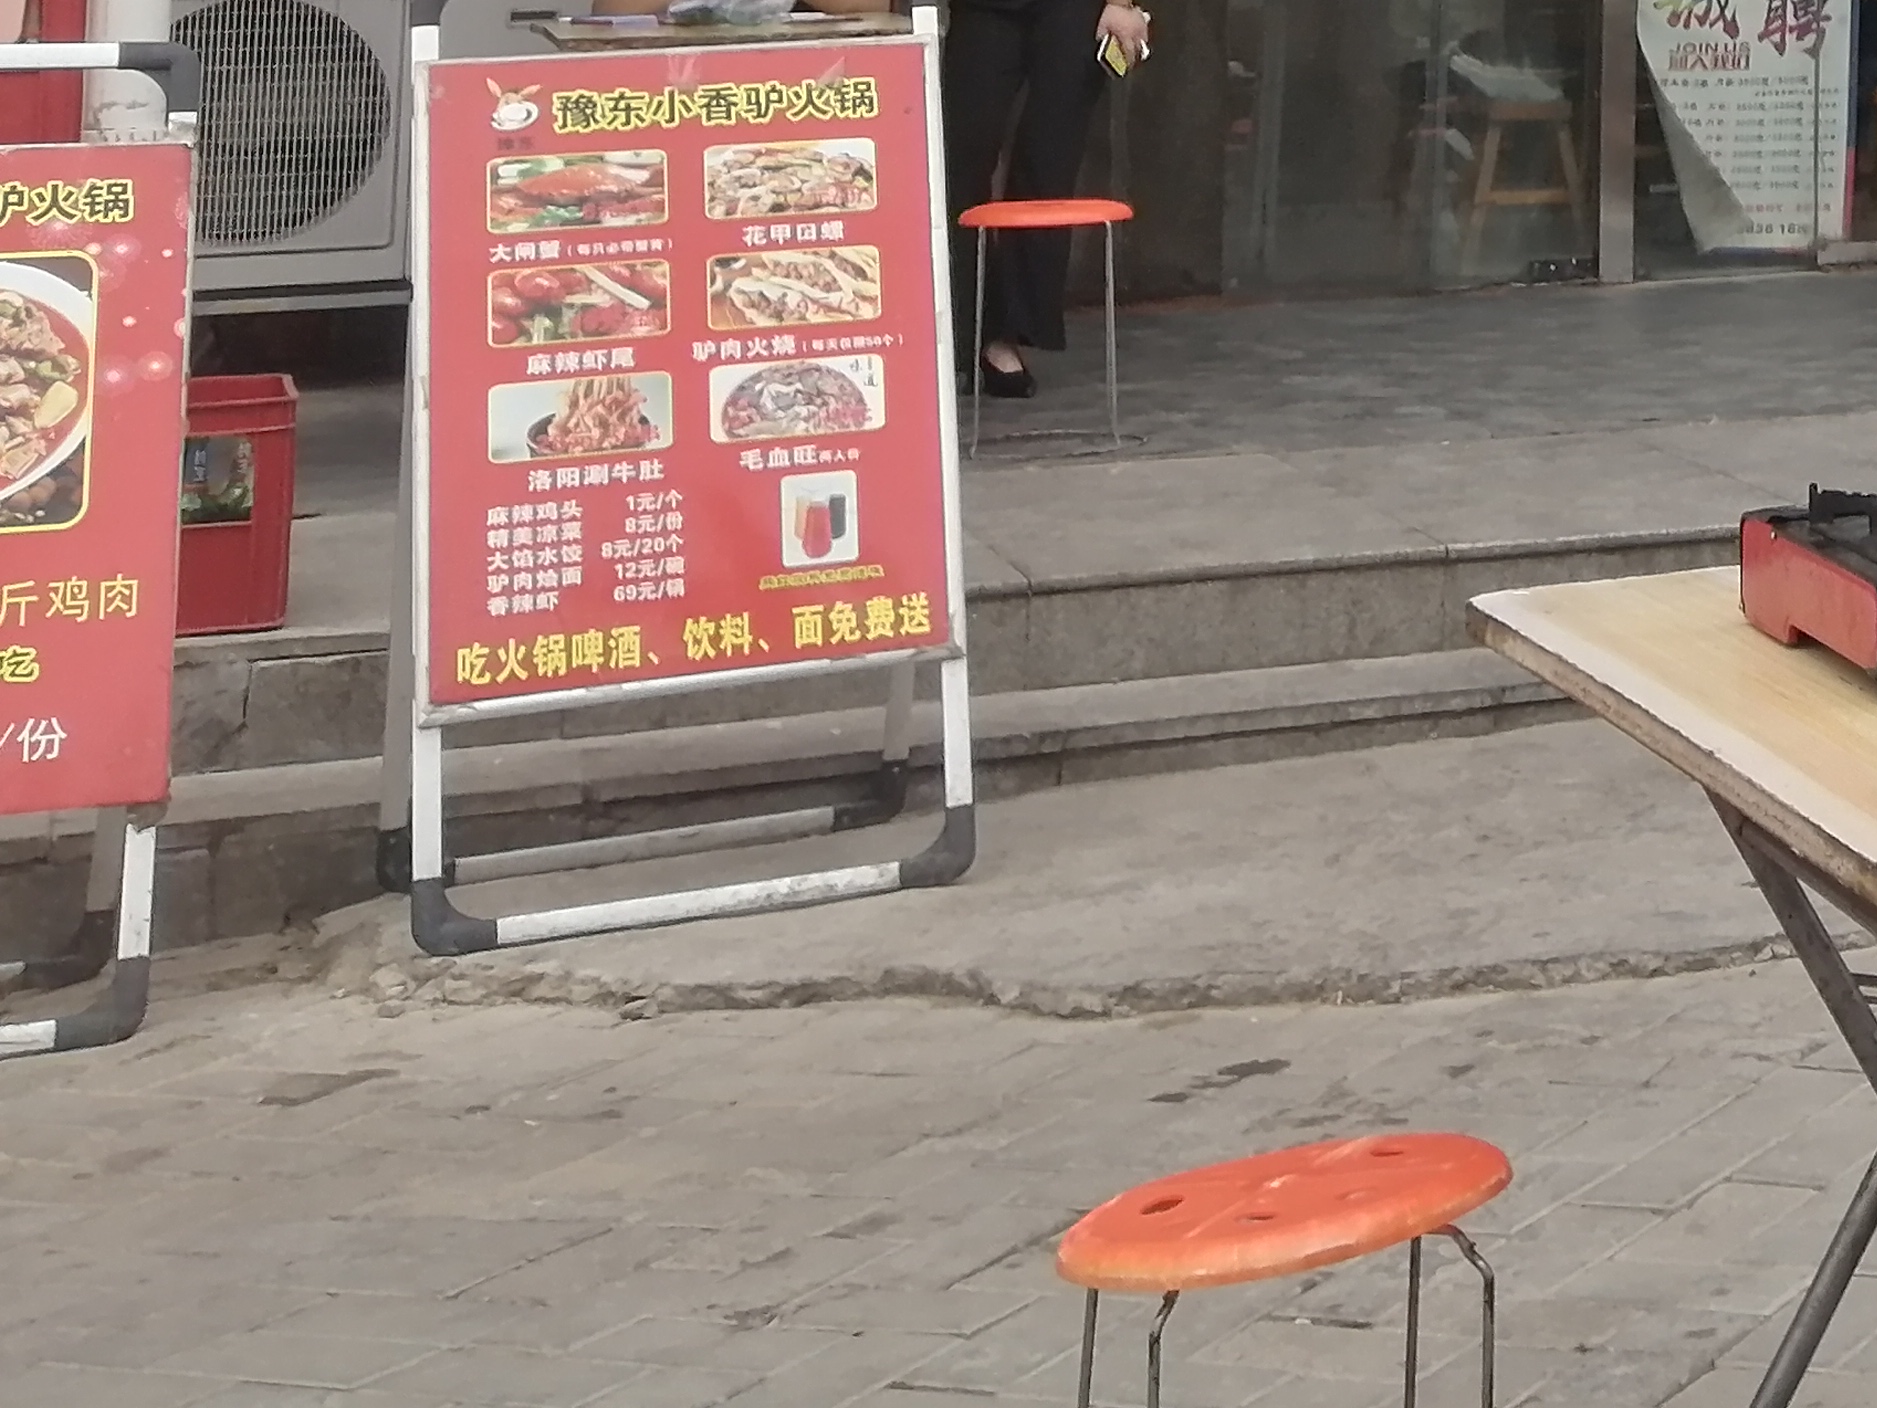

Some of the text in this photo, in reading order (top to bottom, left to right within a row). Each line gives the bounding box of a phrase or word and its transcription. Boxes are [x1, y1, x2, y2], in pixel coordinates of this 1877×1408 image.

[1669, 41, 1718, 54] JOIN
[553, 76, 879, 135] 豫东小香驴火锅
[526, 347, 636, 375] 麻辣虾尾
[527, 459, 665, 492] 洛阳涮牛肚
[486, 489, 683, 527] 麻辣鸡头 1元/个
